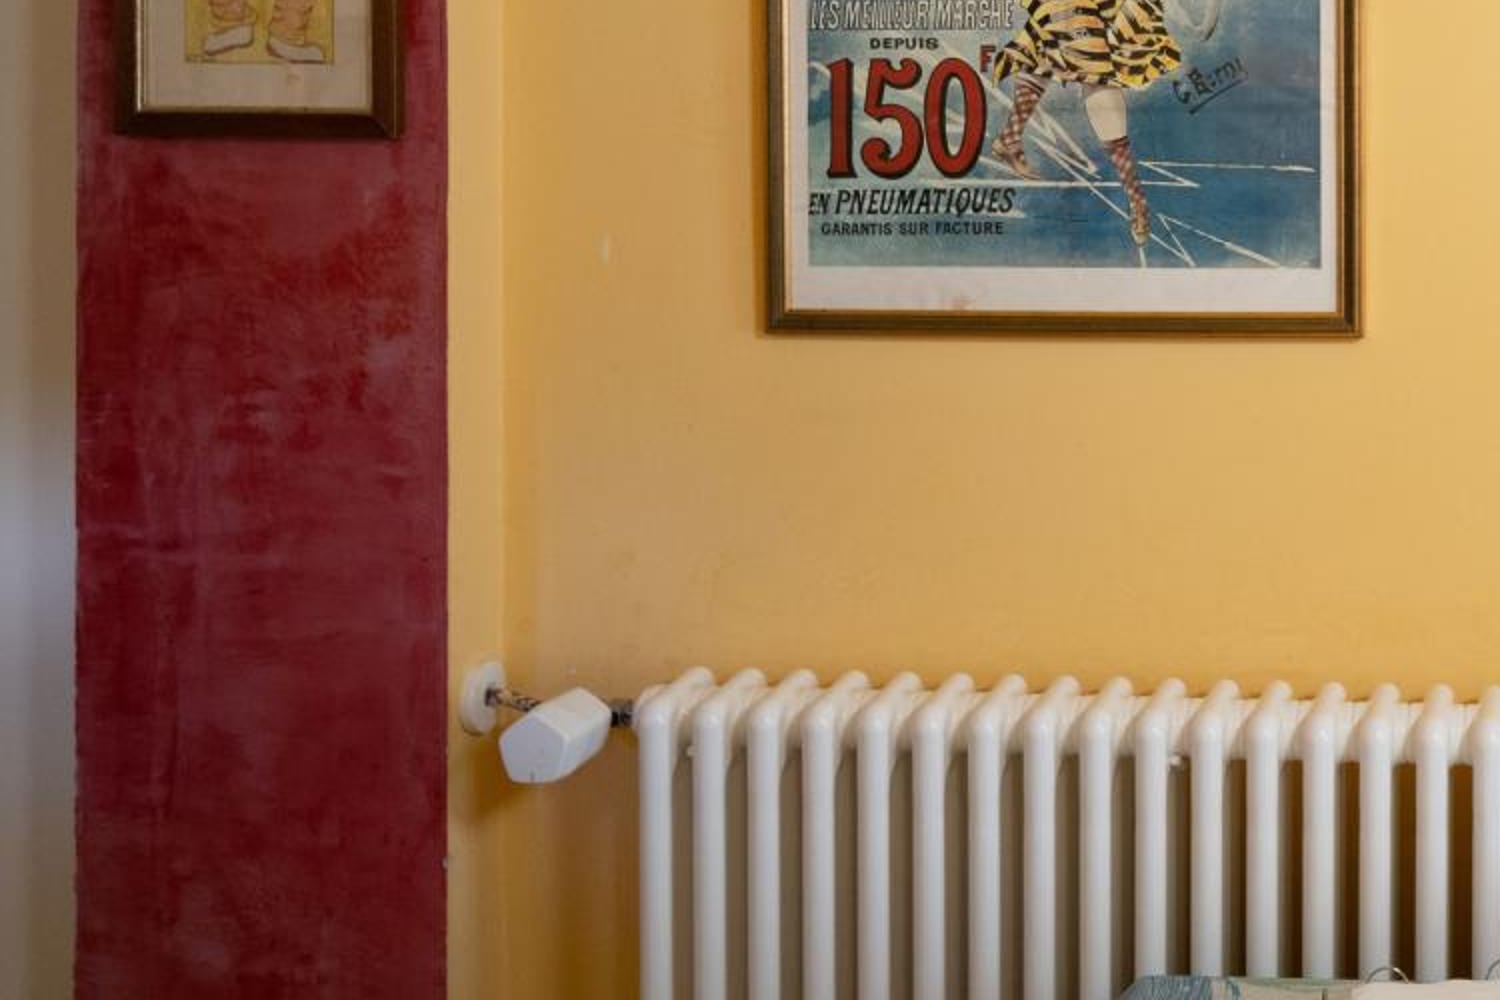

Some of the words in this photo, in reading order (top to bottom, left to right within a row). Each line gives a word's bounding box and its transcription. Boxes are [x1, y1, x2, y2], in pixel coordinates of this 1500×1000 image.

[869, 36, 940, 50] DEPUIS
[808, 192, 830, 215] EN
[835, 187, 1017, 217] PNEUMATIQUES
[821, 221, 892, 236] GARANTIS
[899, 221, 929, 236] SUR
[935, 221, 1004, 236] FACTURE
